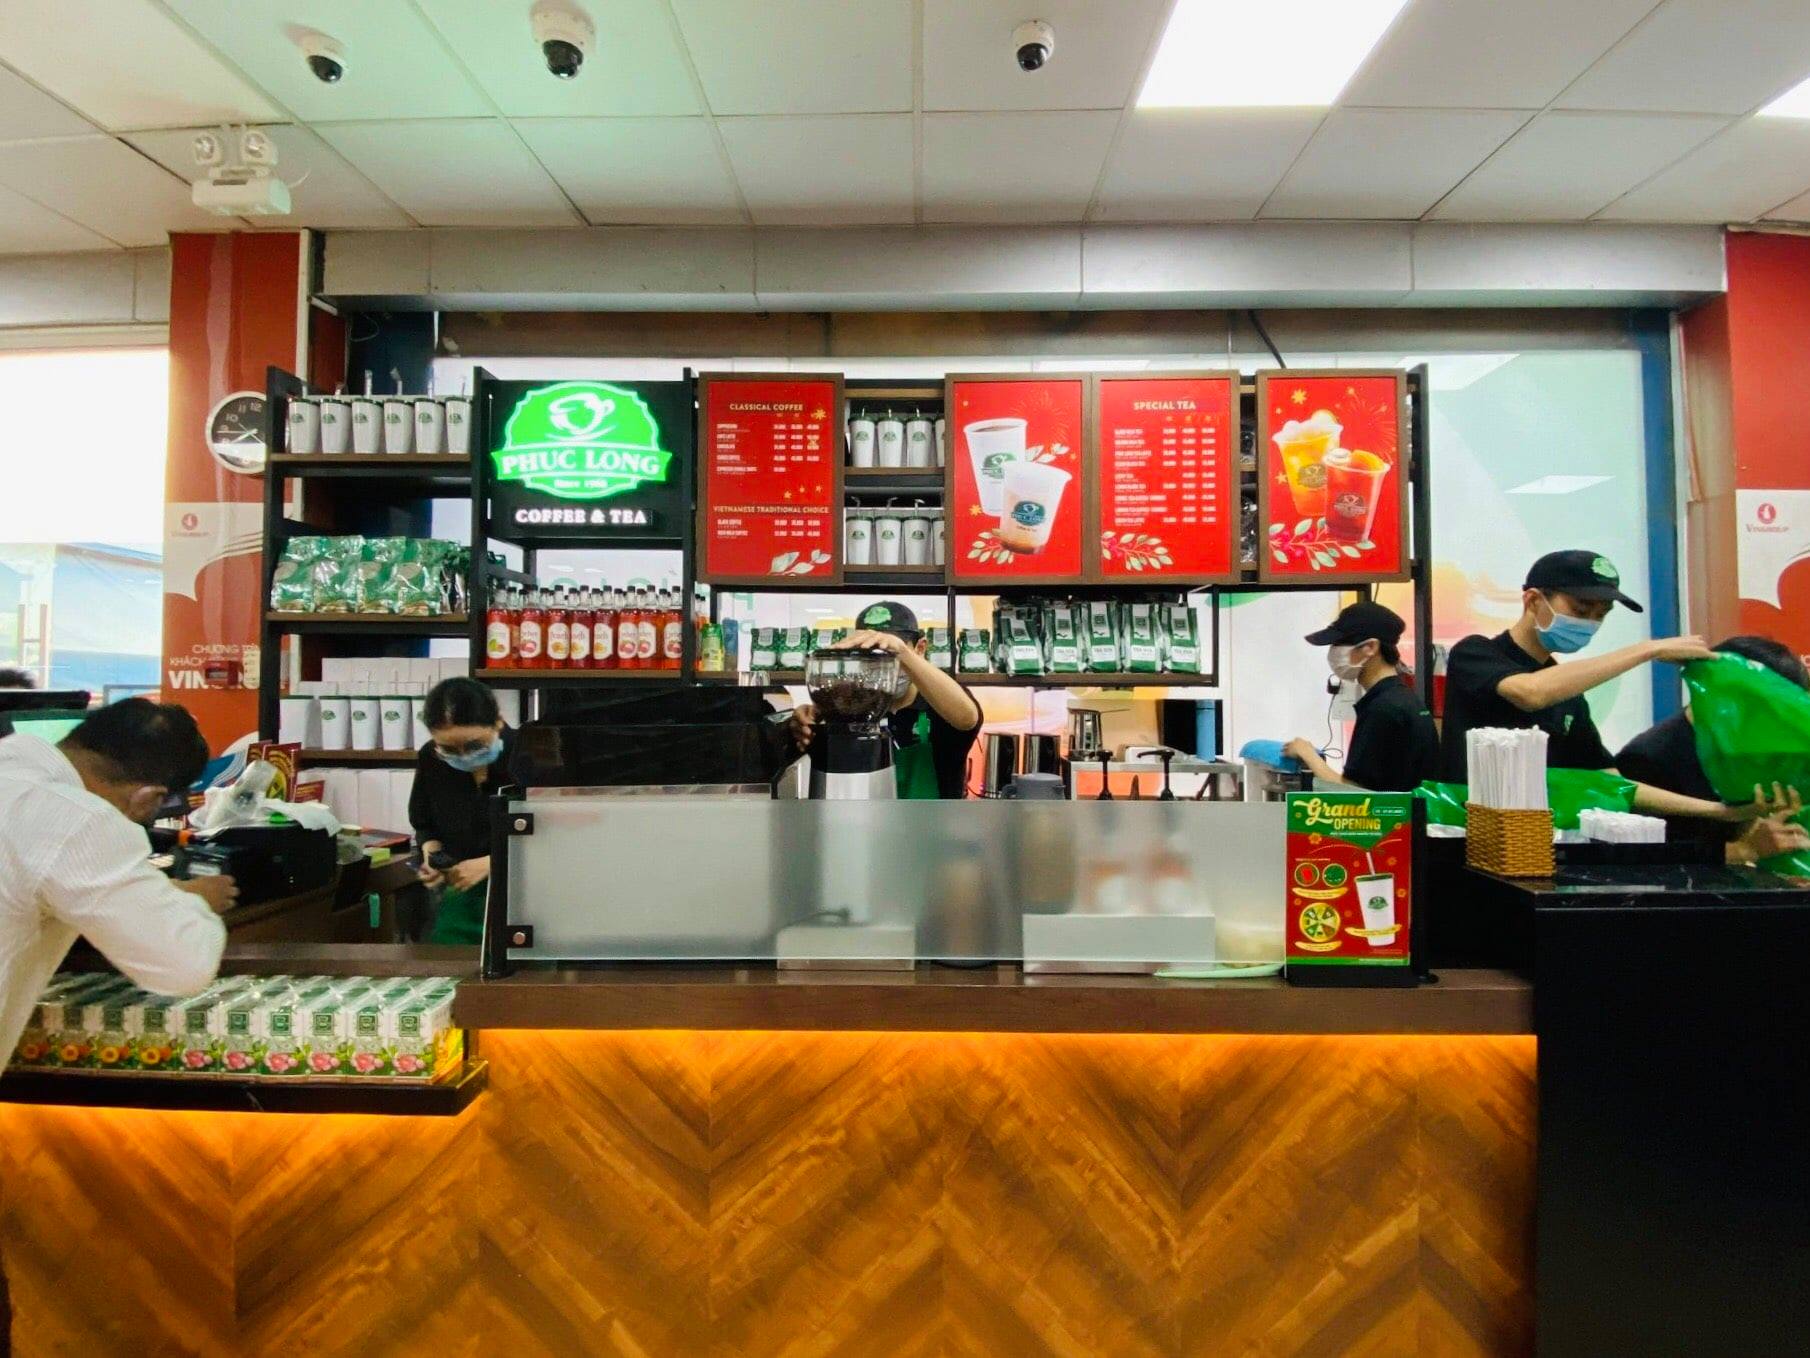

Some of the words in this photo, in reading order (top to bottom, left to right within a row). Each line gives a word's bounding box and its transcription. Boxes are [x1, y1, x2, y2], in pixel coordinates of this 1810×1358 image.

[729, 403, 771, 411] CLASSICAL
[773, 403, 803, 411] COFFEE
[1133, 401, 1175, 410] SPECIAL
[1177, 400, 1196, 410] TEA
[585, 451, 660, 476] LONG
[713, 505, 756, 513] VIETNAMESE
[757, 505, 802, 513] TRADITIONAL
[802, 506, 829, 514] CHOICE
[515, 509, 586, 524] COFFEE
[589, 509, 605, 524] &
[610, 509, 647, 524] TEA
[1293, 797, 1372, 826] Grand
[1334, 818, 1381, 830] OPENING
